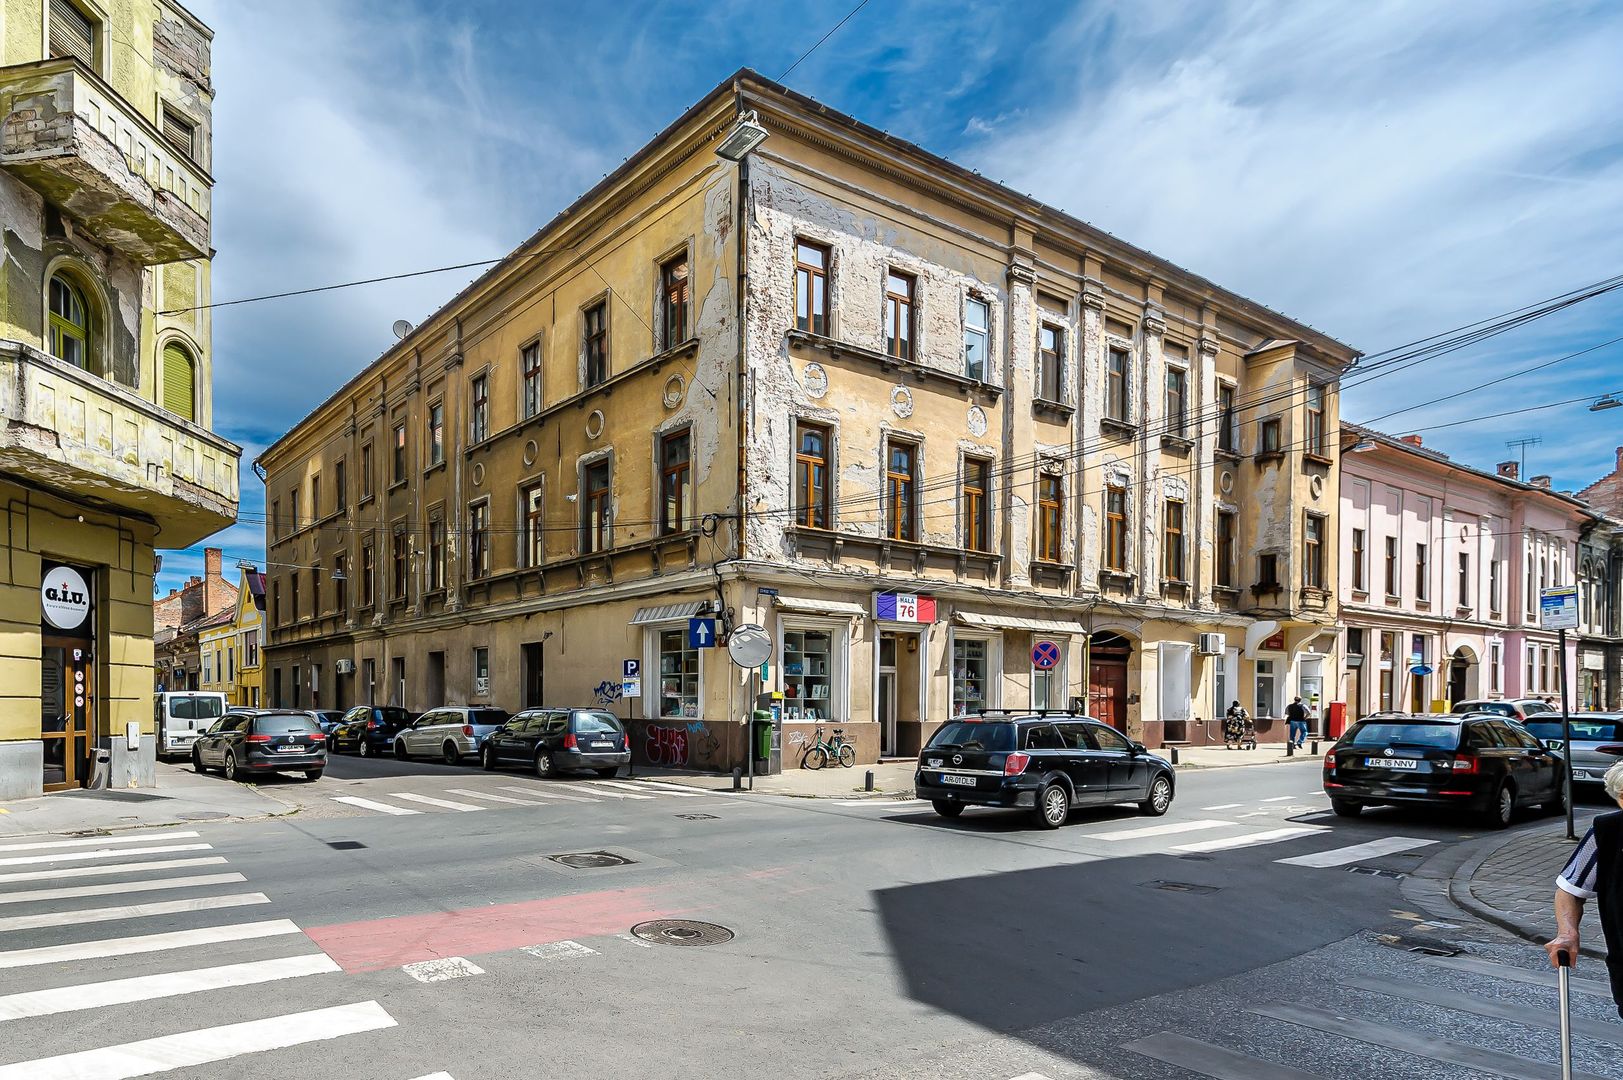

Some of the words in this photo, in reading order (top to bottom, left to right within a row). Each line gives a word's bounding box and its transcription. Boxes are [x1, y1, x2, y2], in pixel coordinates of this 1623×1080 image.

[45, 587, 86, 605] G.I.U.
[900, 605, 915, 618] 76
[628, 661, 636, 674] P
[1394, 760, 1414, 768] NNV
